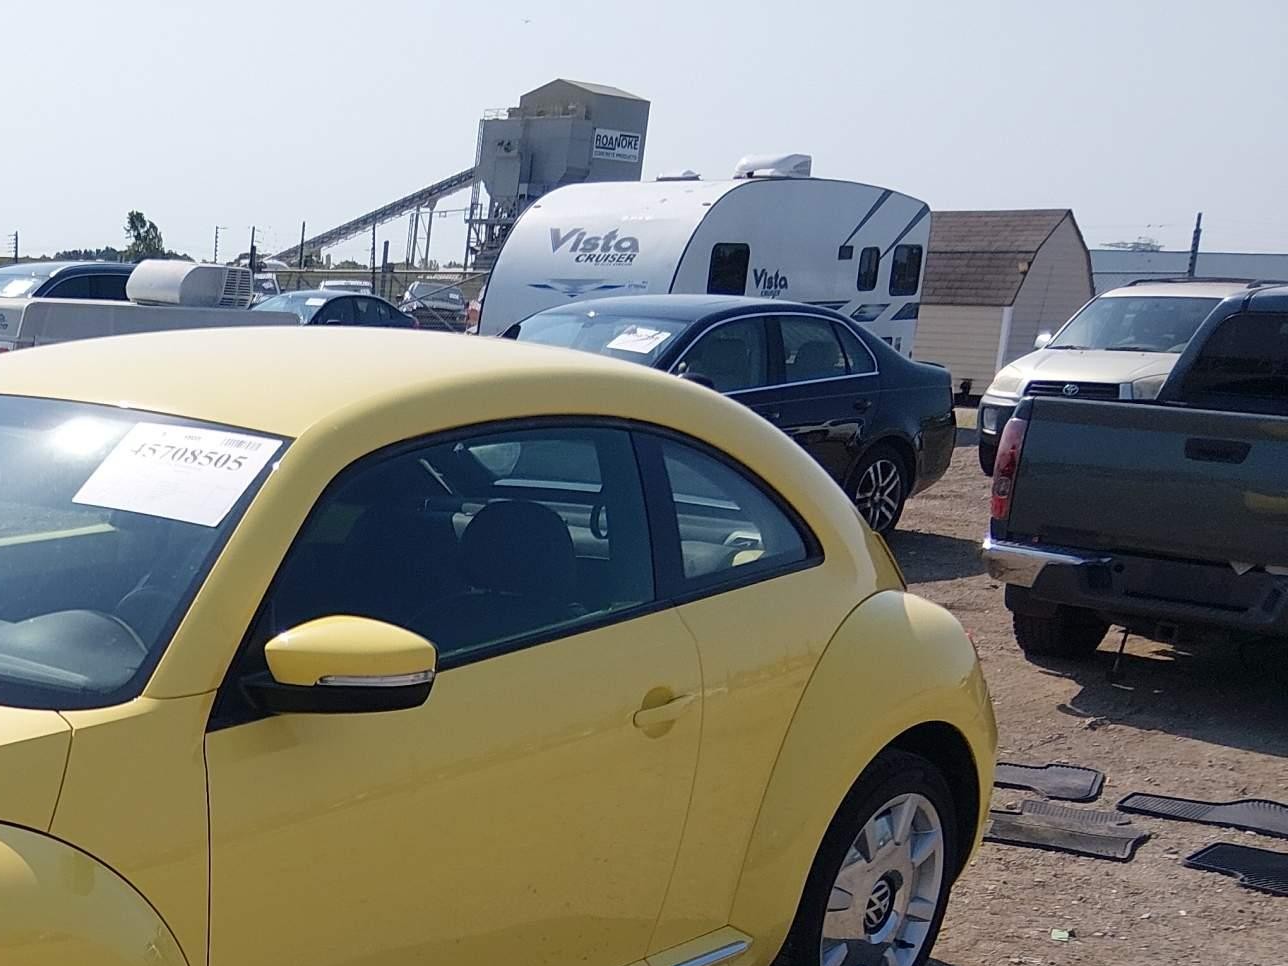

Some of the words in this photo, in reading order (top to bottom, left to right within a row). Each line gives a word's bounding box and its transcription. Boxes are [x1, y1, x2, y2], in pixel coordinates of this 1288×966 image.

[595, 134, 639, 150] ROANOKE
[550, 227, 640, 253] Vista
[575, 253, 637, 263] CRUISER
[753, 268, 788, 290] Vista
[130, 442, 248, 471] 45708505
